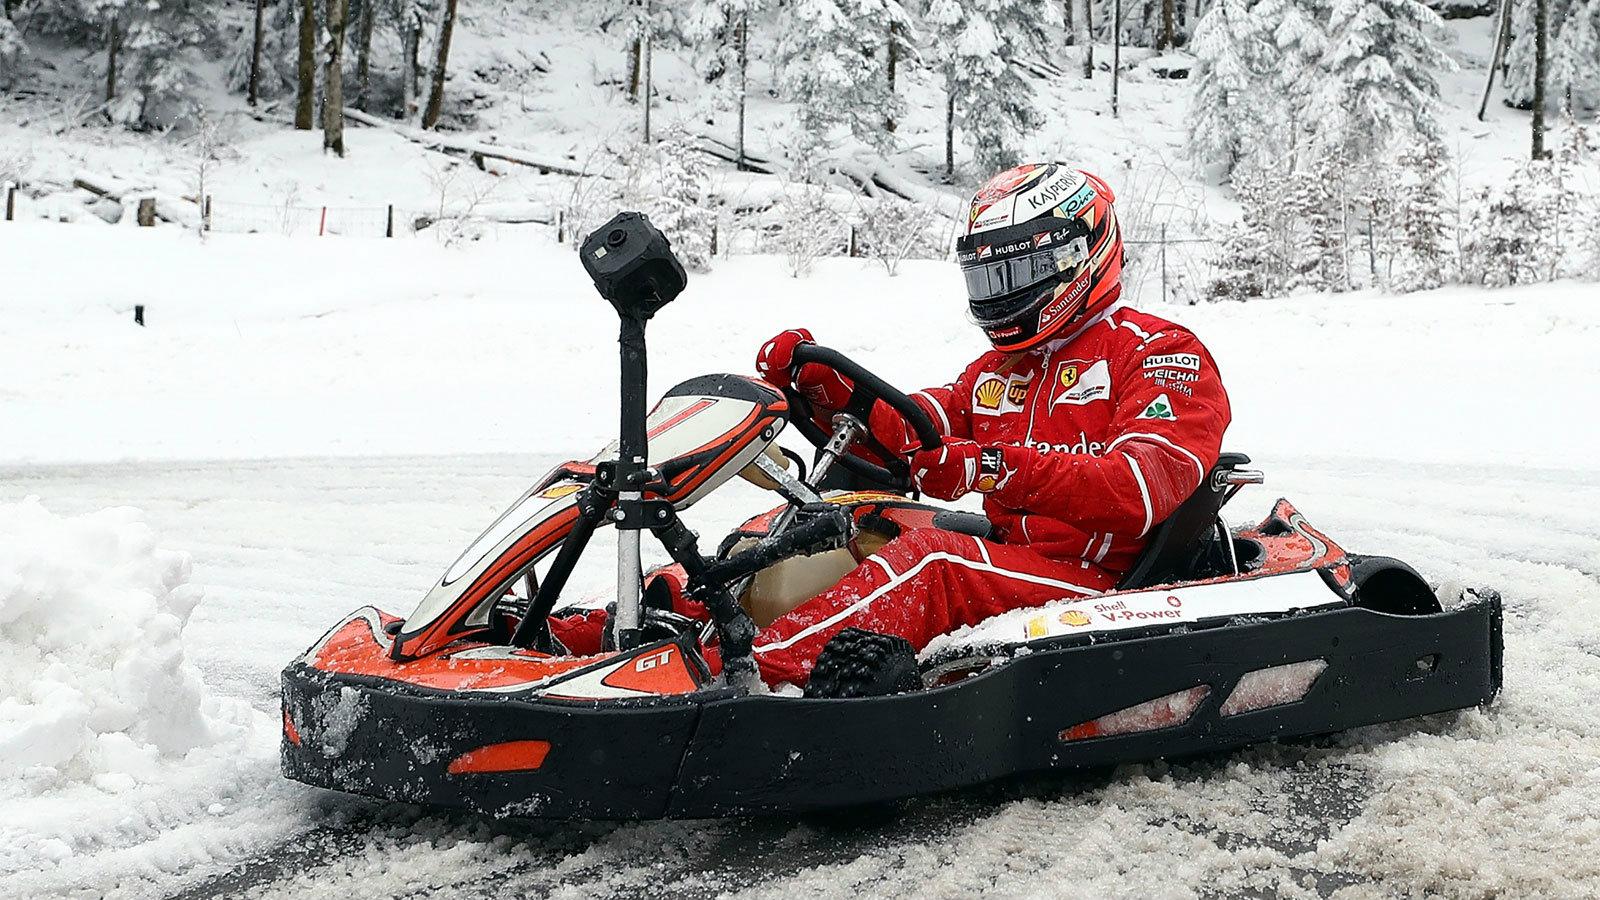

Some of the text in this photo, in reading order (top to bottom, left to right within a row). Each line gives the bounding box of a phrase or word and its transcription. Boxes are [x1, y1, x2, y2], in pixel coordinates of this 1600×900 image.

[1028, 169, 1077, 209] KASPERSK
[1065, 190, 1095, 217] Riva
[995, 241, 1031, 255] HUBLOT
[1049, 276, 1089, 316] Santander
[1144, 356, 1199, 366] HUBLOT
[1143, 370, 1199, 382] WEICHAI
[1095, 601, 1127, 612] Shell
[1101, 610, 1181, 622] V-Power
[635, 649, 675, 672] GT
